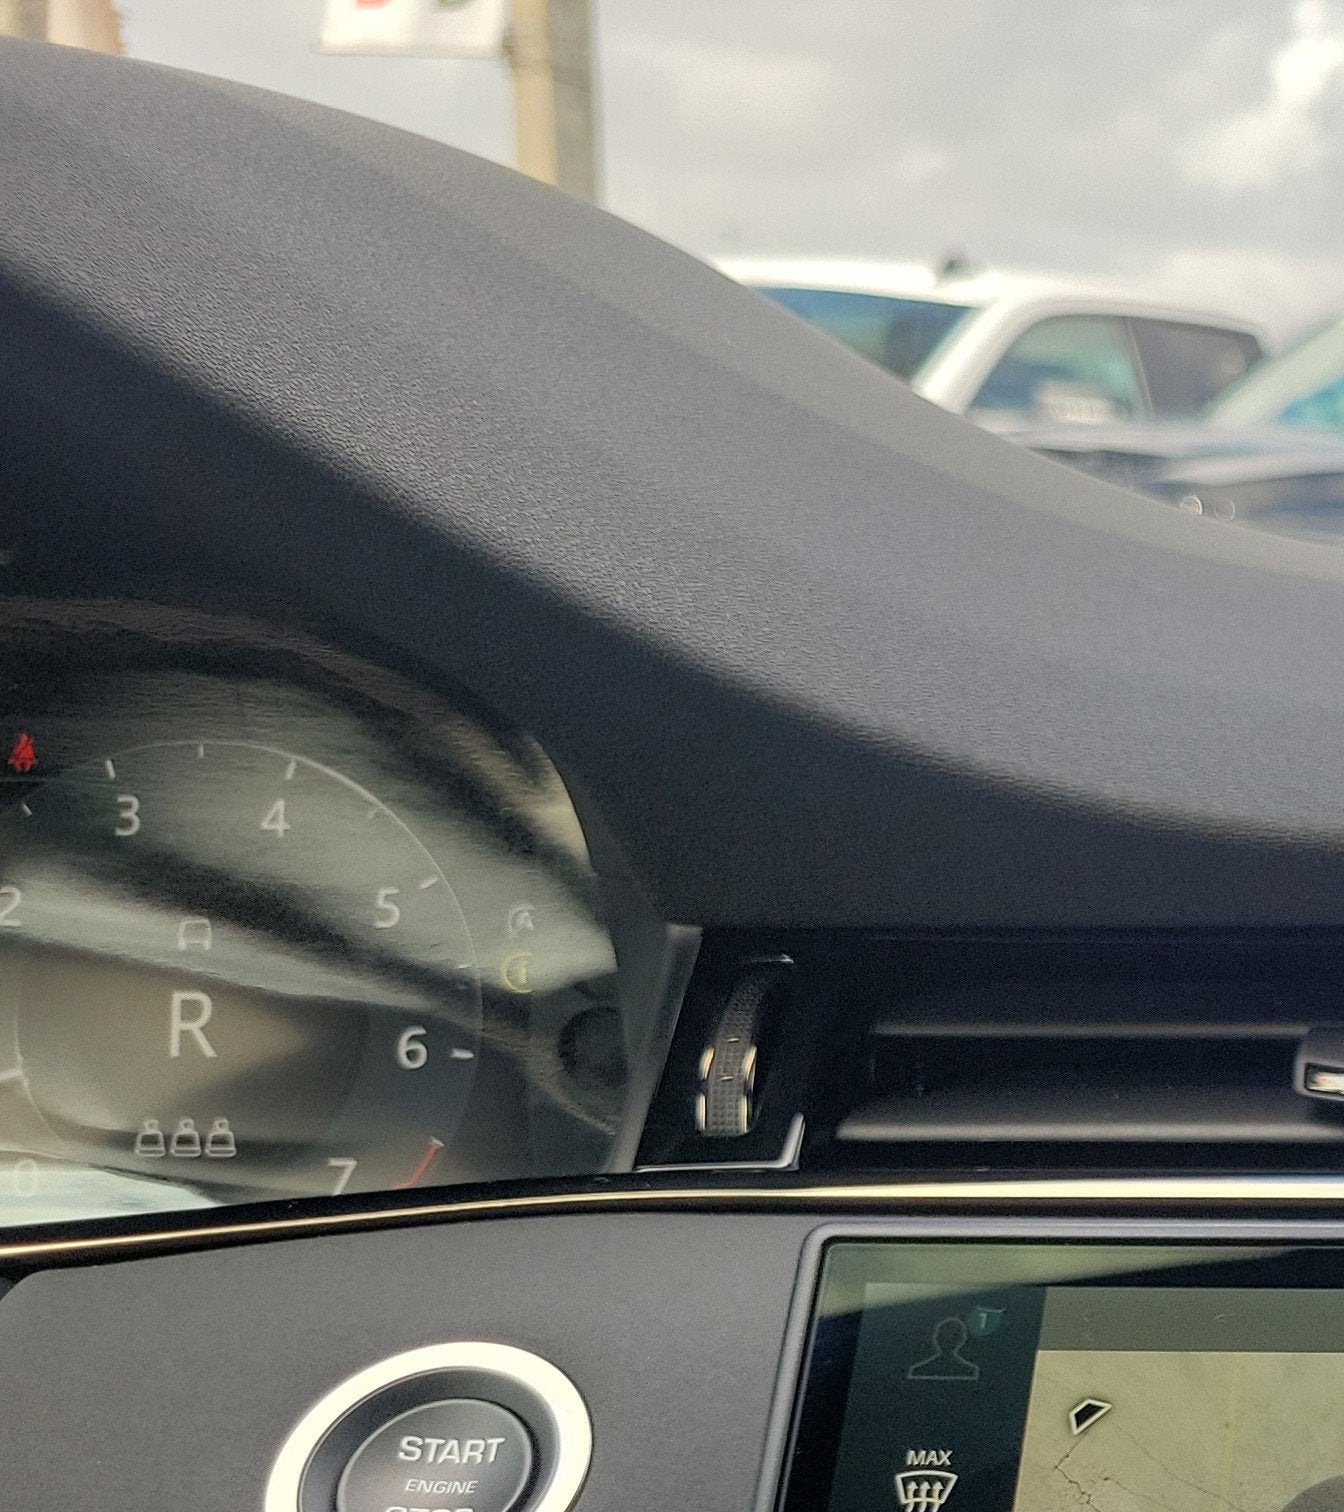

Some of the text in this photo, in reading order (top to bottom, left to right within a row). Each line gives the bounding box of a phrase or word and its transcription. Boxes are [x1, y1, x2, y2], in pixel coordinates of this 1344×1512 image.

[115, 796, 140, 836] 3
[260, 799, 290, 838] 4
[0, 886, 22, 926] 2
[374, 889, 400, 929] 5
[168, 991, 217, 1057] R
[398, 1028, 428, 1068] 6
[328, 1158, 357, 1195] 7
[399, 1436, 505, 1464] START
[906, 1450, 951, 1466] MAX
[405, 1478, 478, 1495] ENGINE
